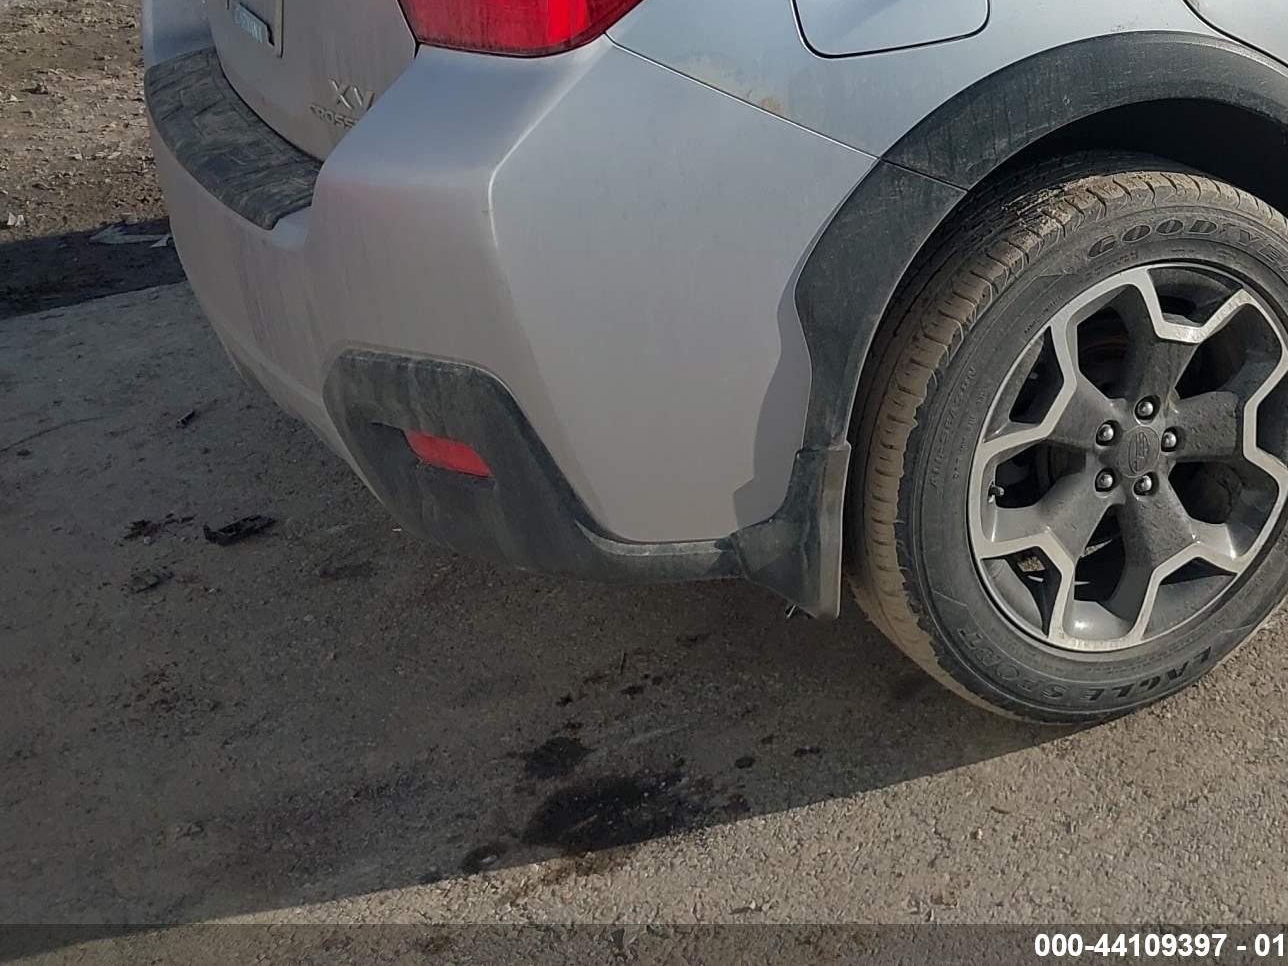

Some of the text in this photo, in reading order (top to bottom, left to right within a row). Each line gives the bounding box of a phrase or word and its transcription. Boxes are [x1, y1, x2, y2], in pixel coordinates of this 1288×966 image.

[328, 78, 375, 111] XV
[308, 102, 360, 129] CROSS
[1080, 646, 1212, 701] EAGLE
